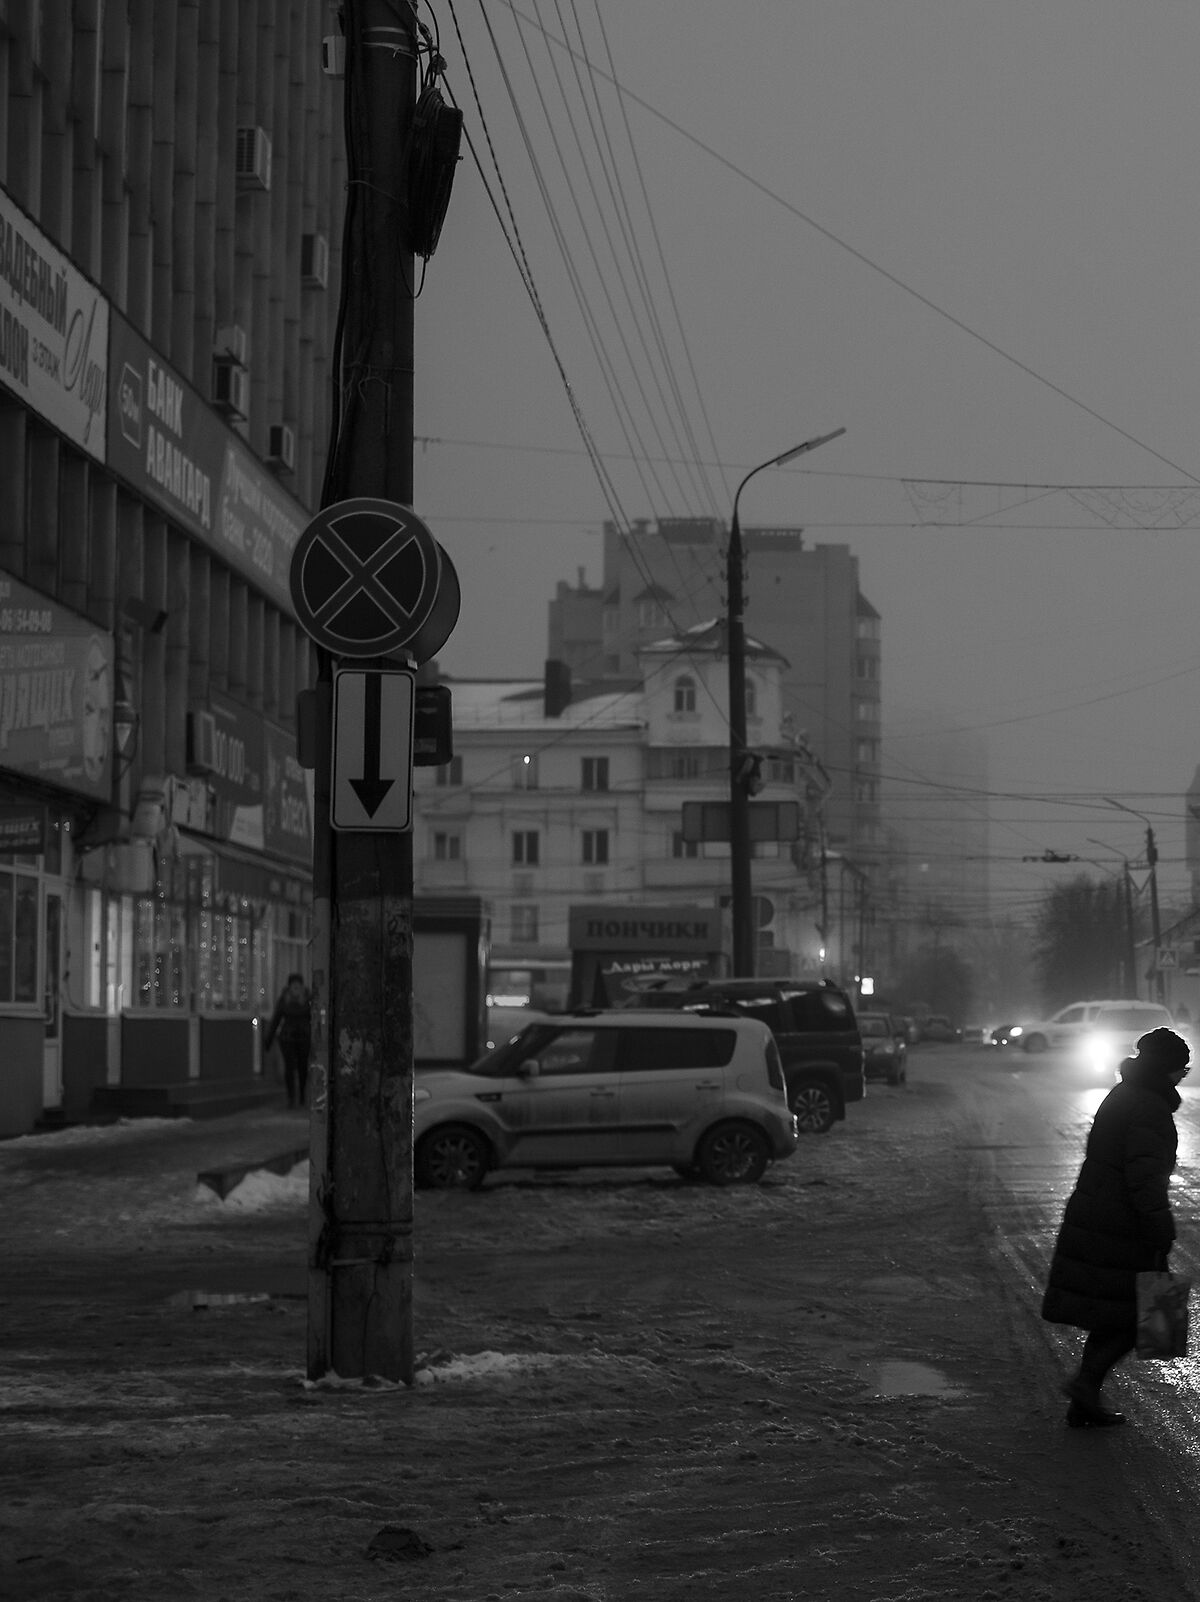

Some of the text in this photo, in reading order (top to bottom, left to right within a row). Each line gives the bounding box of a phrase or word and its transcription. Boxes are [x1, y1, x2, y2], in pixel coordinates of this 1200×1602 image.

[147, 357, 183, 439] БАНК
[146, 424, 211, 530] АВАНГАРД
[586, 919, 709, 939] ПОНЧИКИ
[602, 960, 654, 975] Дары
[659, 960, 708, 971] моря
